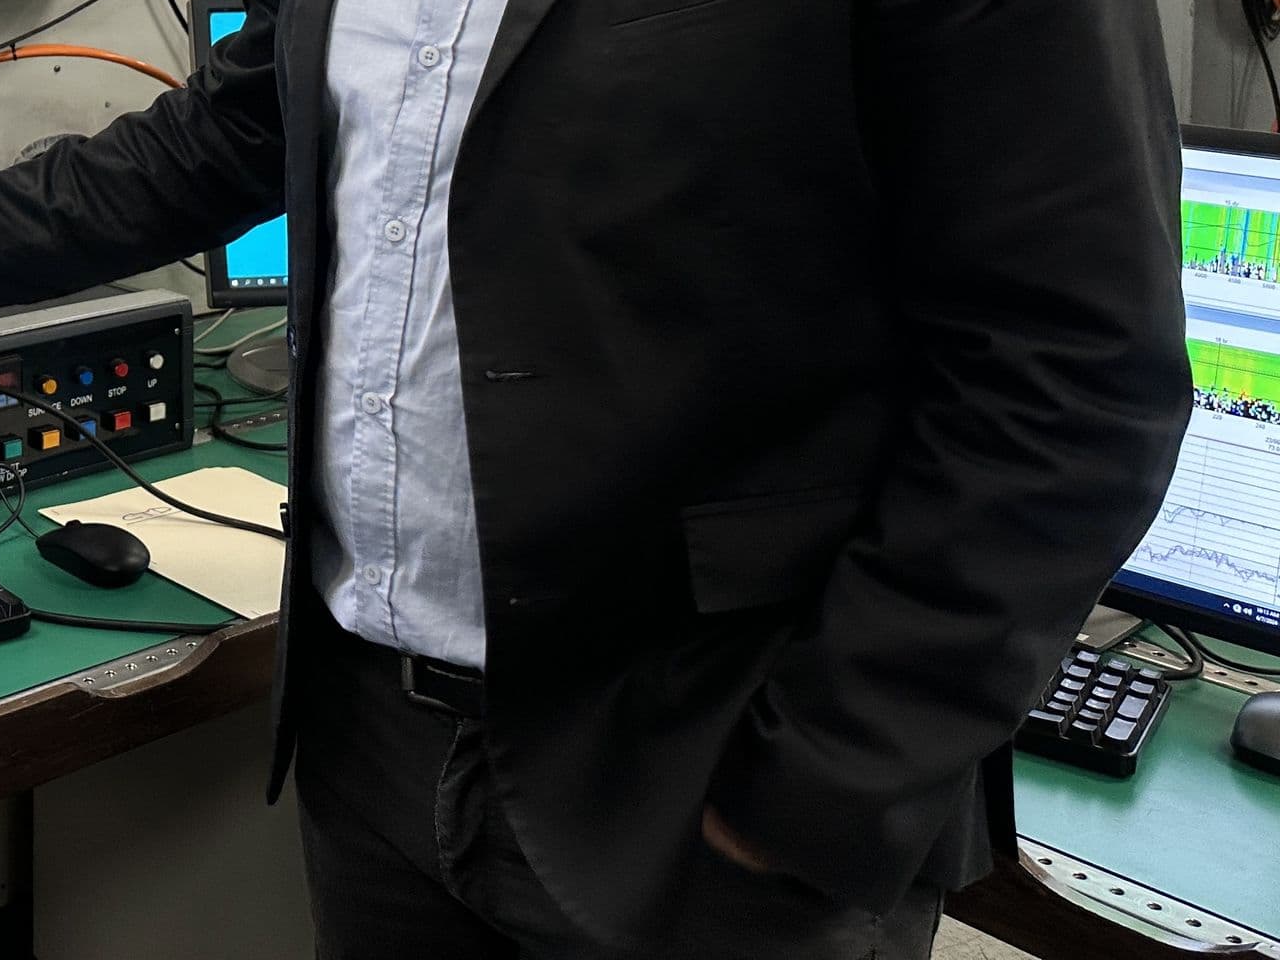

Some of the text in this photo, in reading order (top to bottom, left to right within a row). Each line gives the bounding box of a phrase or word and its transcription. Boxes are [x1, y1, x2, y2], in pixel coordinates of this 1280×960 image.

[147, 378, 158, 388] UP
[108, 385, 127, 398] STOP
[70, 394, 93, 407] DOWN
